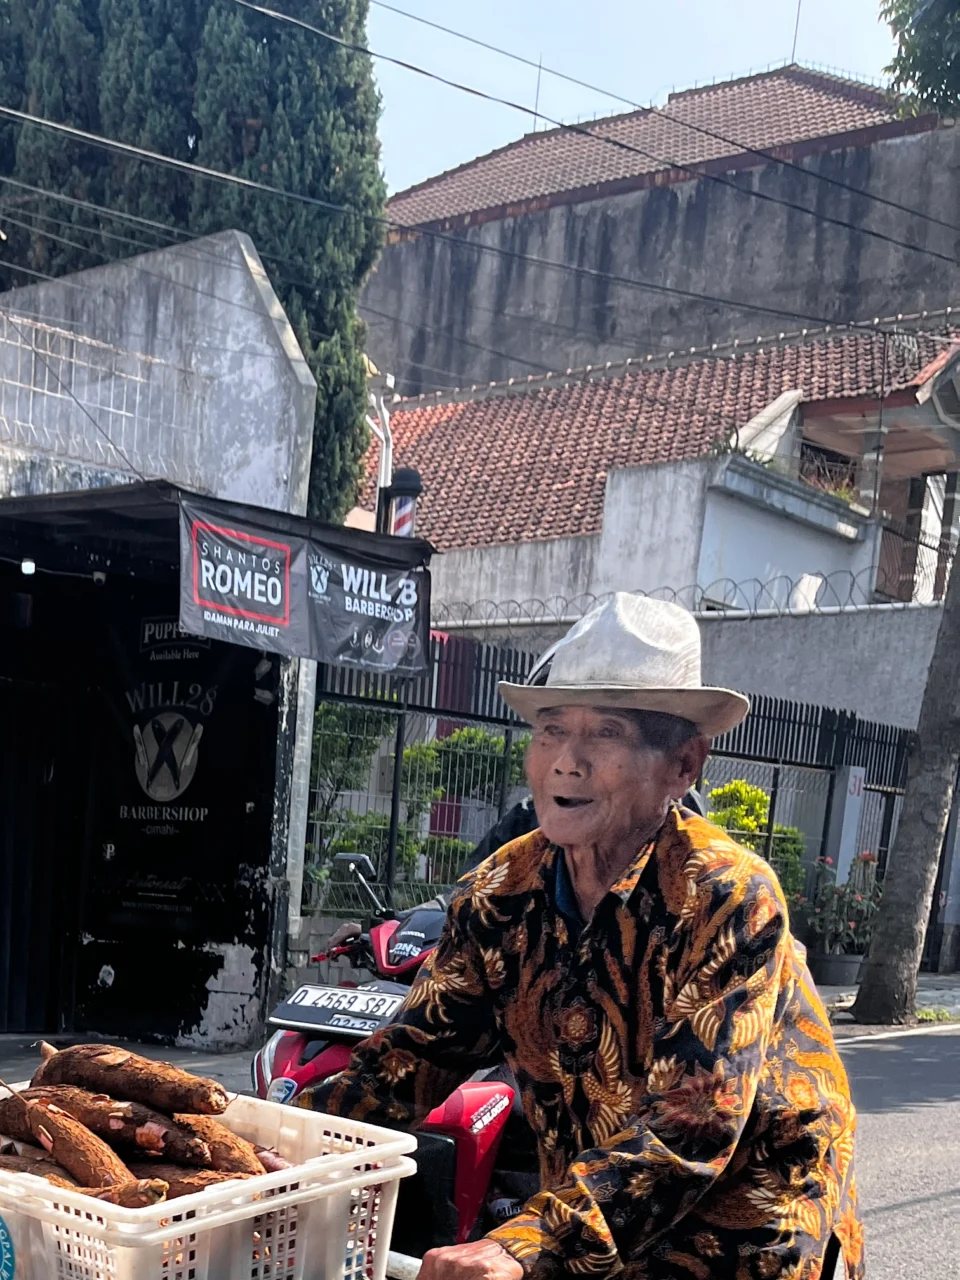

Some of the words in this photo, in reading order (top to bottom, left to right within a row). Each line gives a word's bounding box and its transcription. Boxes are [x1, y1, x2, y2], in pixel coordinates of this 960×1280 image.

[201, 542, 280, 574] SHANTOS
[201, 558, 282, 606] ROMEO
[341, 563, 392, 602] WILL
[203, 610, 232, 628] IDAMAN
[233, 618, 255, 633] PARA
[255, 623, 280, 637] JULIET
[849, 775, 862, 797] 31
[119, 805, 209, 822] BARBERSHOP
[312, 991, 358, 1010] 4569
